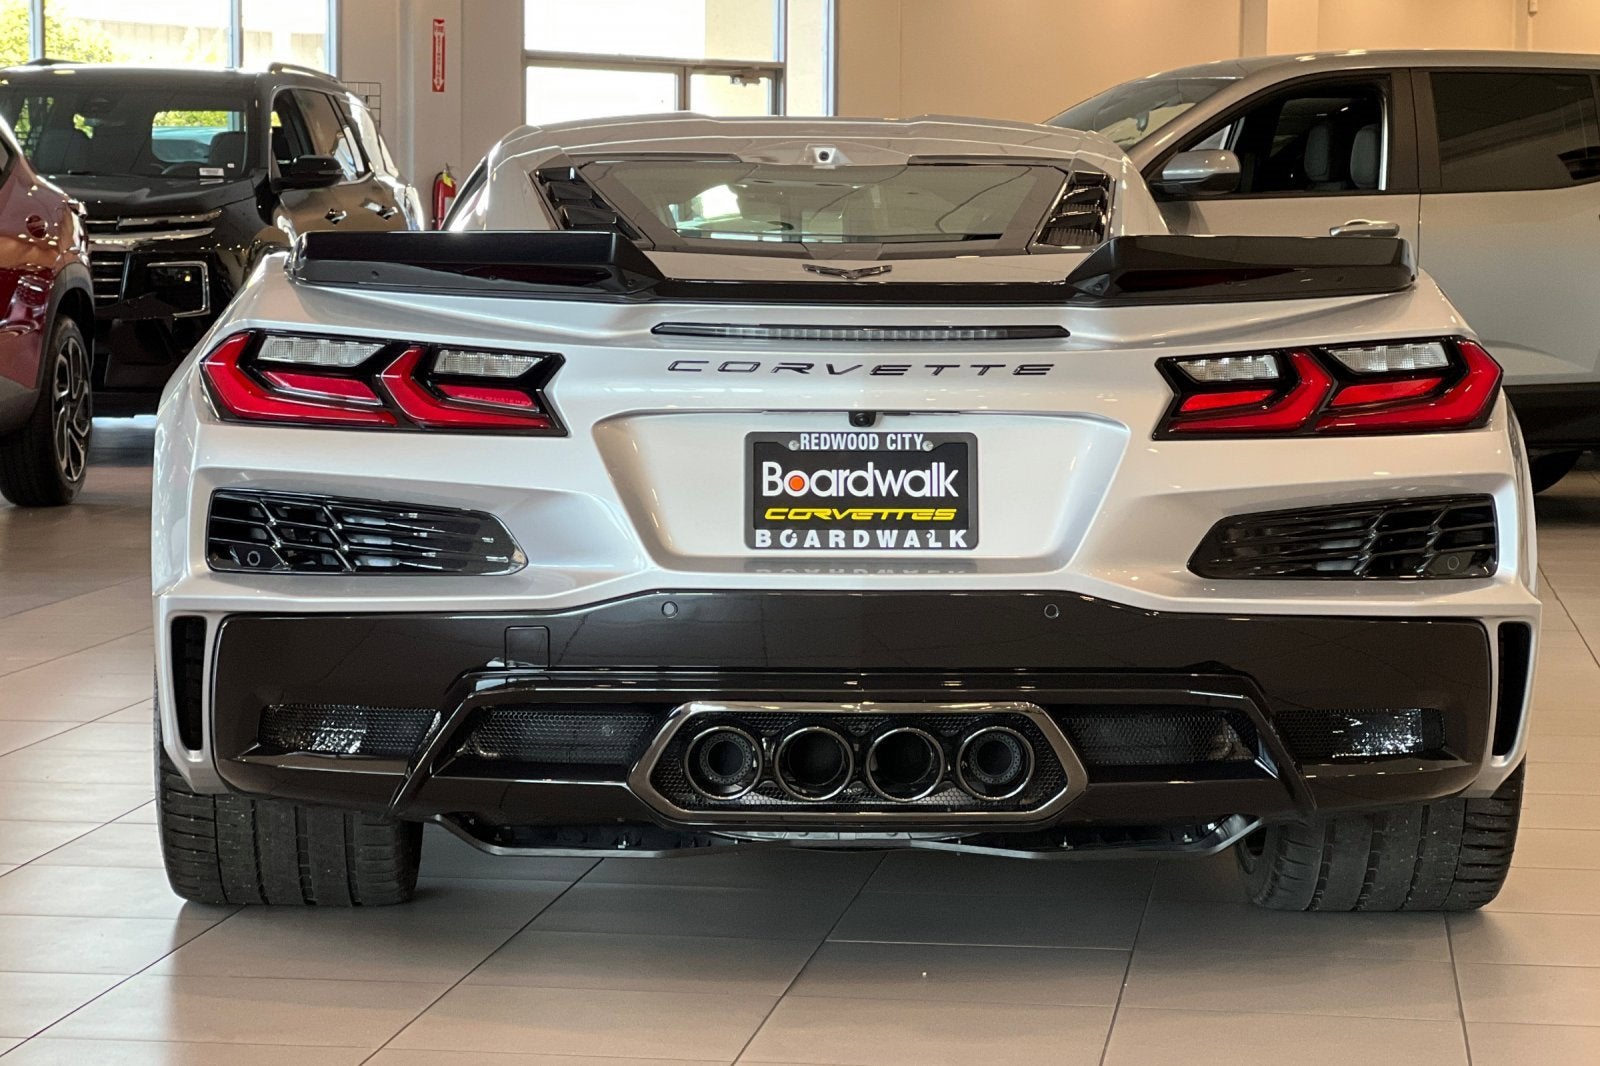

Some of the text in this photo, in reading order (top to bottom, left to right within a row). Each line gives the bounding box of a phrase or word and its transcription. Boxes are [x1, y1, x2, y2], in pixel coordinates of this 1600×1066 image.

[668, 360, 1054, 376] CORVETTE
[800, 433, 924, 451] REDWOOD CITY
[762, 461, 959, 498] Boardwalk
[764, 507, 957, 521] CORVETTES
[755, 529, 968, 548] BOARDWALK
